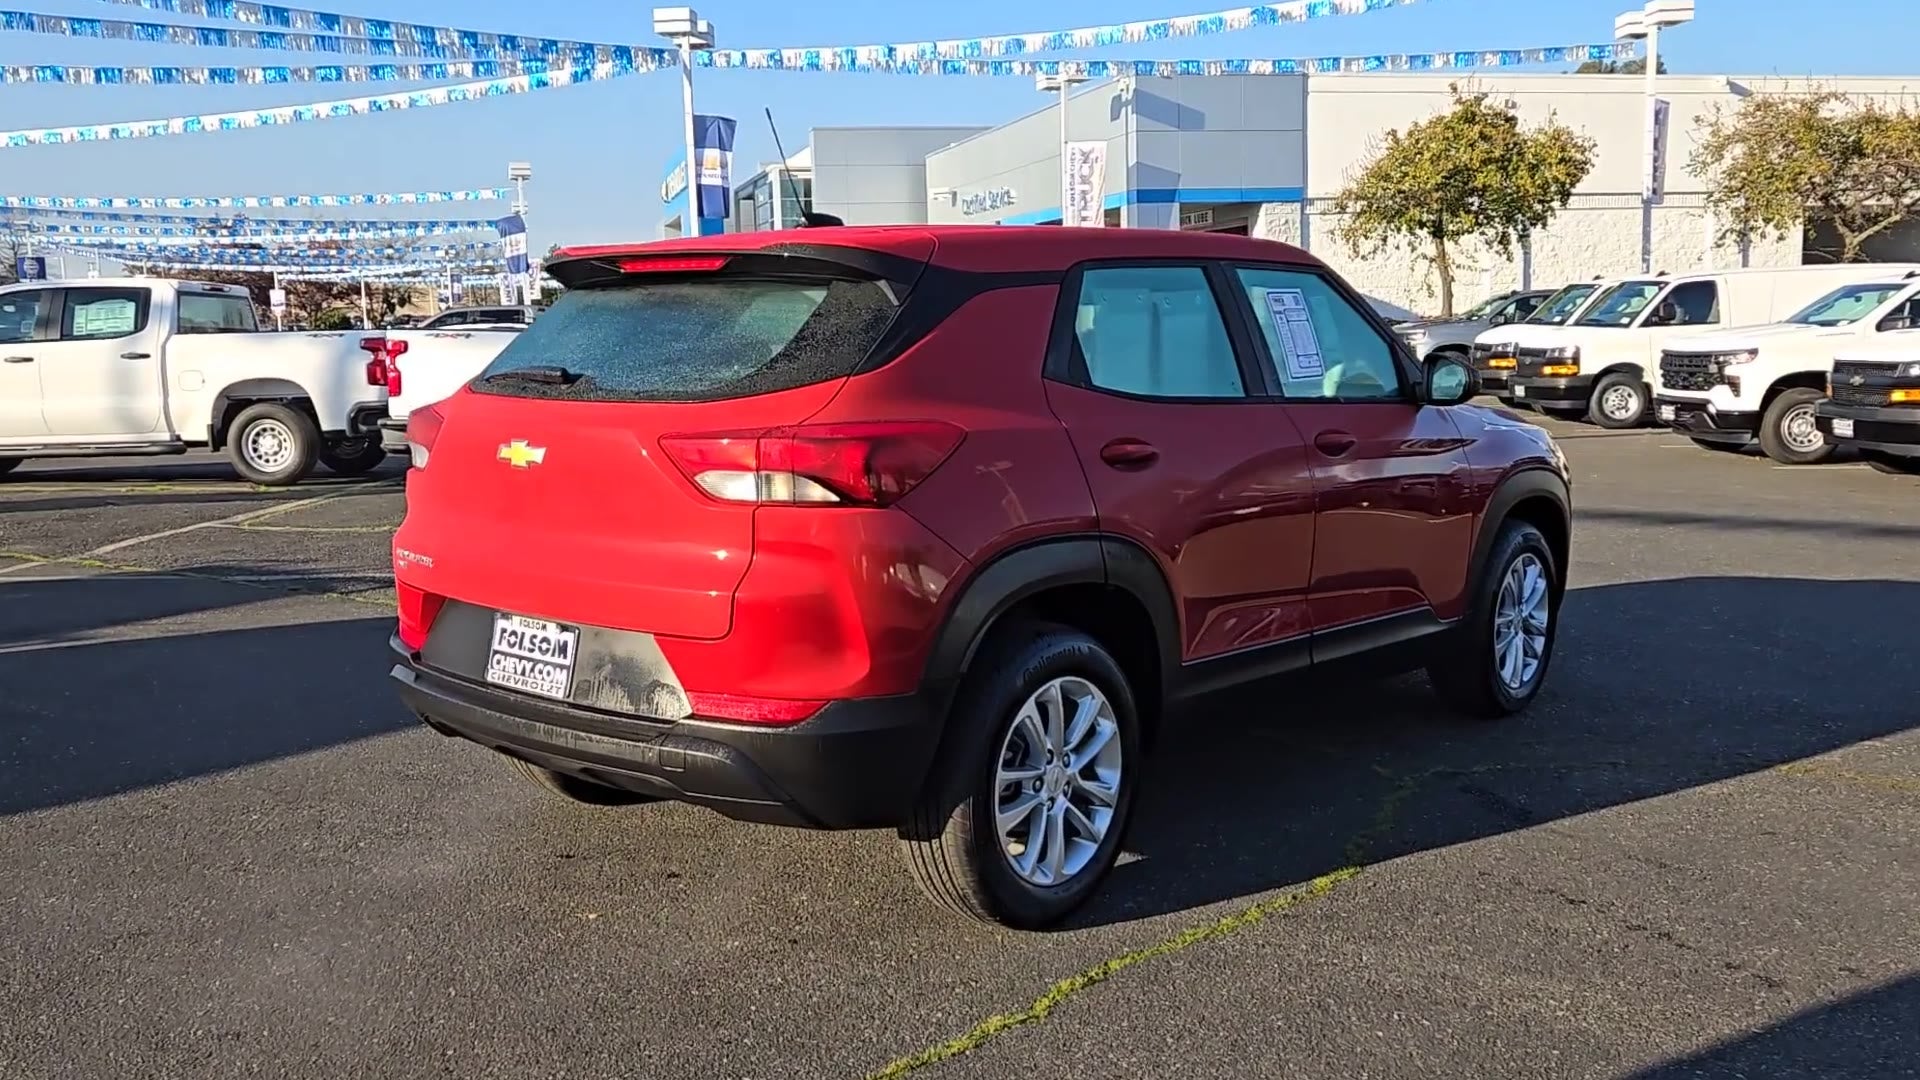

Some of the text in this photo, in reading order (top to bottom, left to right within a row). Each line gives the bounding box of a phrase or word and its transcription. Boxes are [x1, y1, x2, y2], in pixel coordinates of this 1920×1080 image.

[1077, 147, 1095, 224] TRUCK
[1193, 211, 1209, 224] LUBE
[519, 618, 548, 632] FOLSOM
[498, 627, 569, 660] FOLSOM
[490, 671, 562, 695] CHEVROLET
[492, 653, 568, 685] CHEVY.COM
